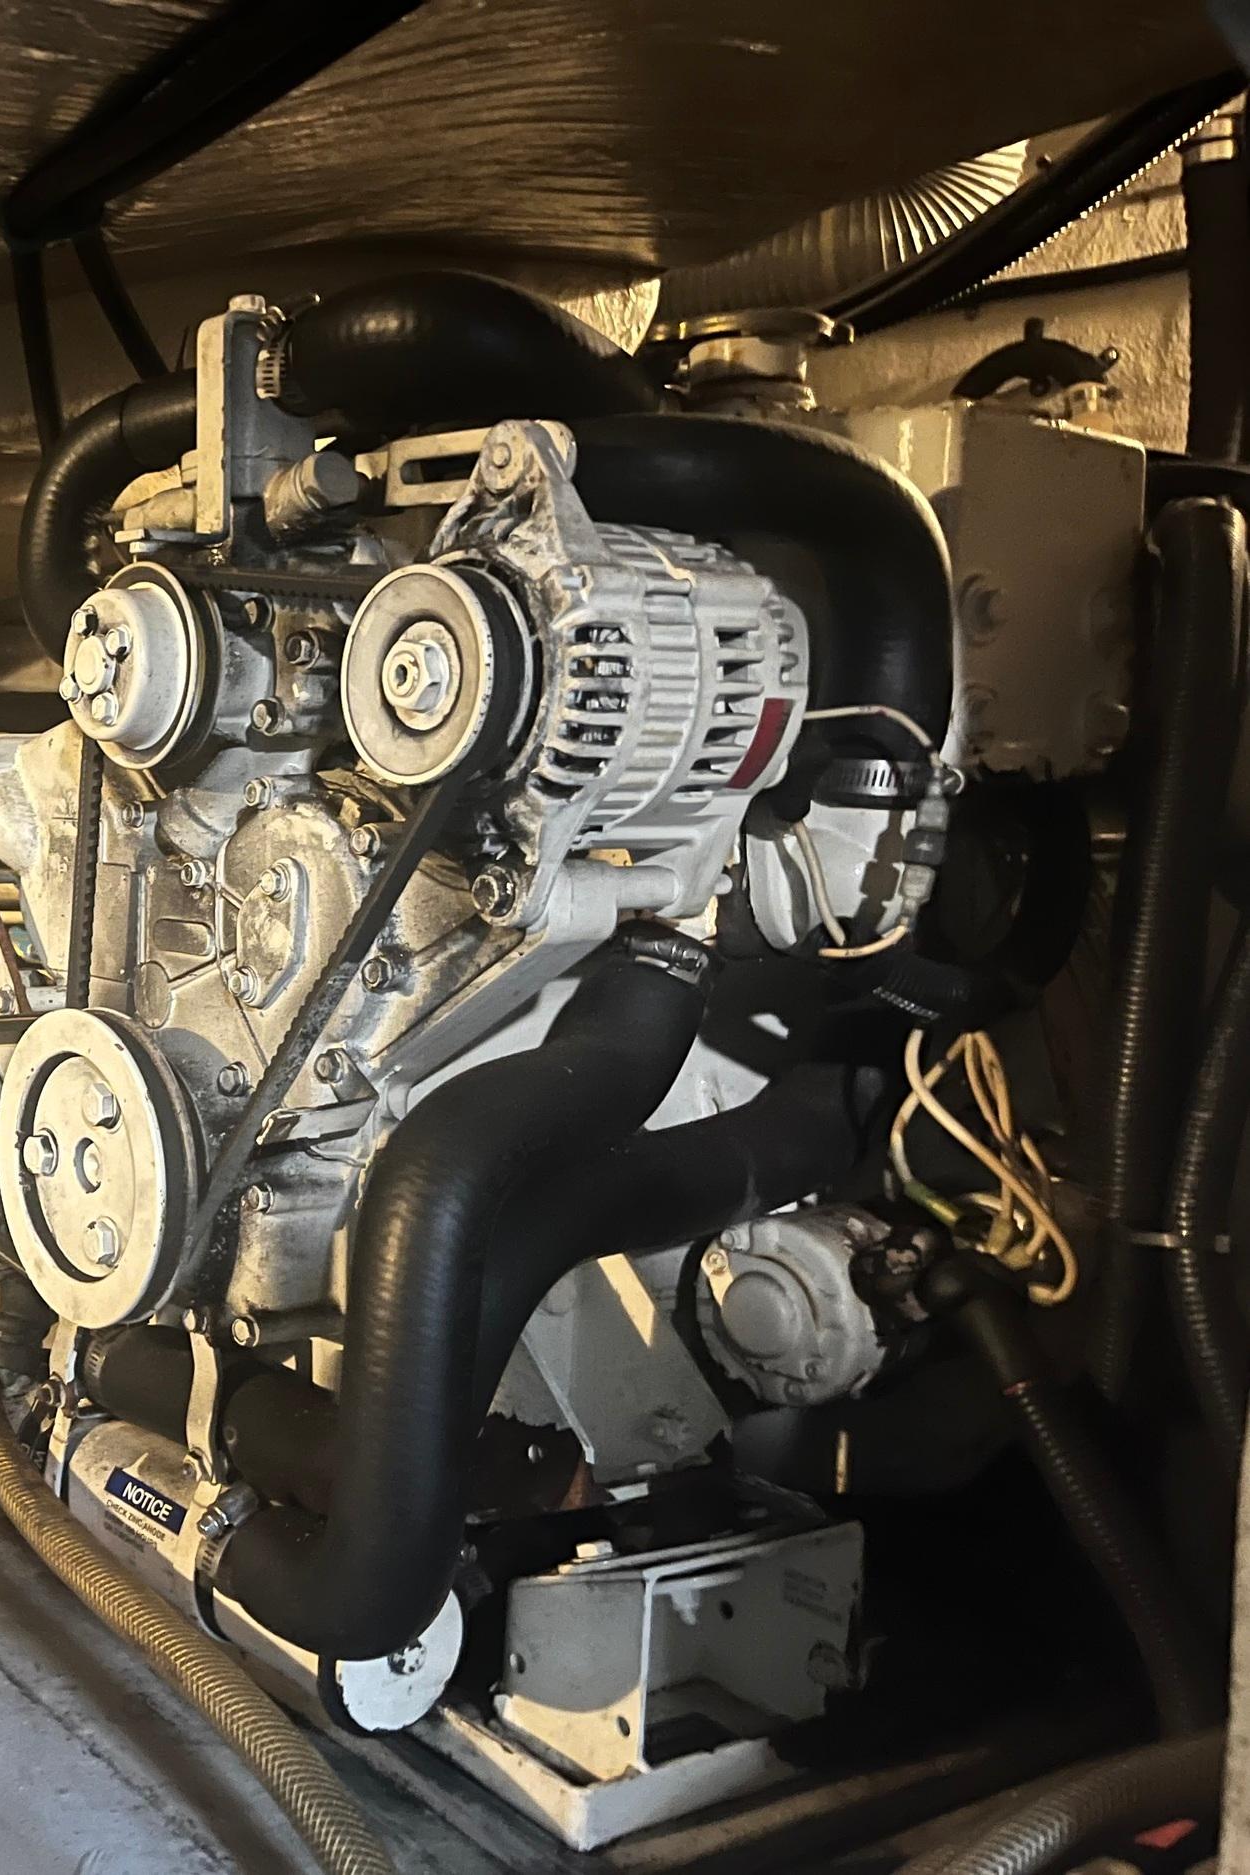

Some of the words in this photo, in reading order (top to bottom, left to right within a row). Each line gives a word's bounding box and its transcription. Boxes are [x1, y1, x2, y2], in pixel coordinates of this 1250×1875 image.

[106, 1499, 127, 1518] CHECK
[143, 1522, 167, 1542] ANODE
[122, 1481, 173, 1522] NOTICE
